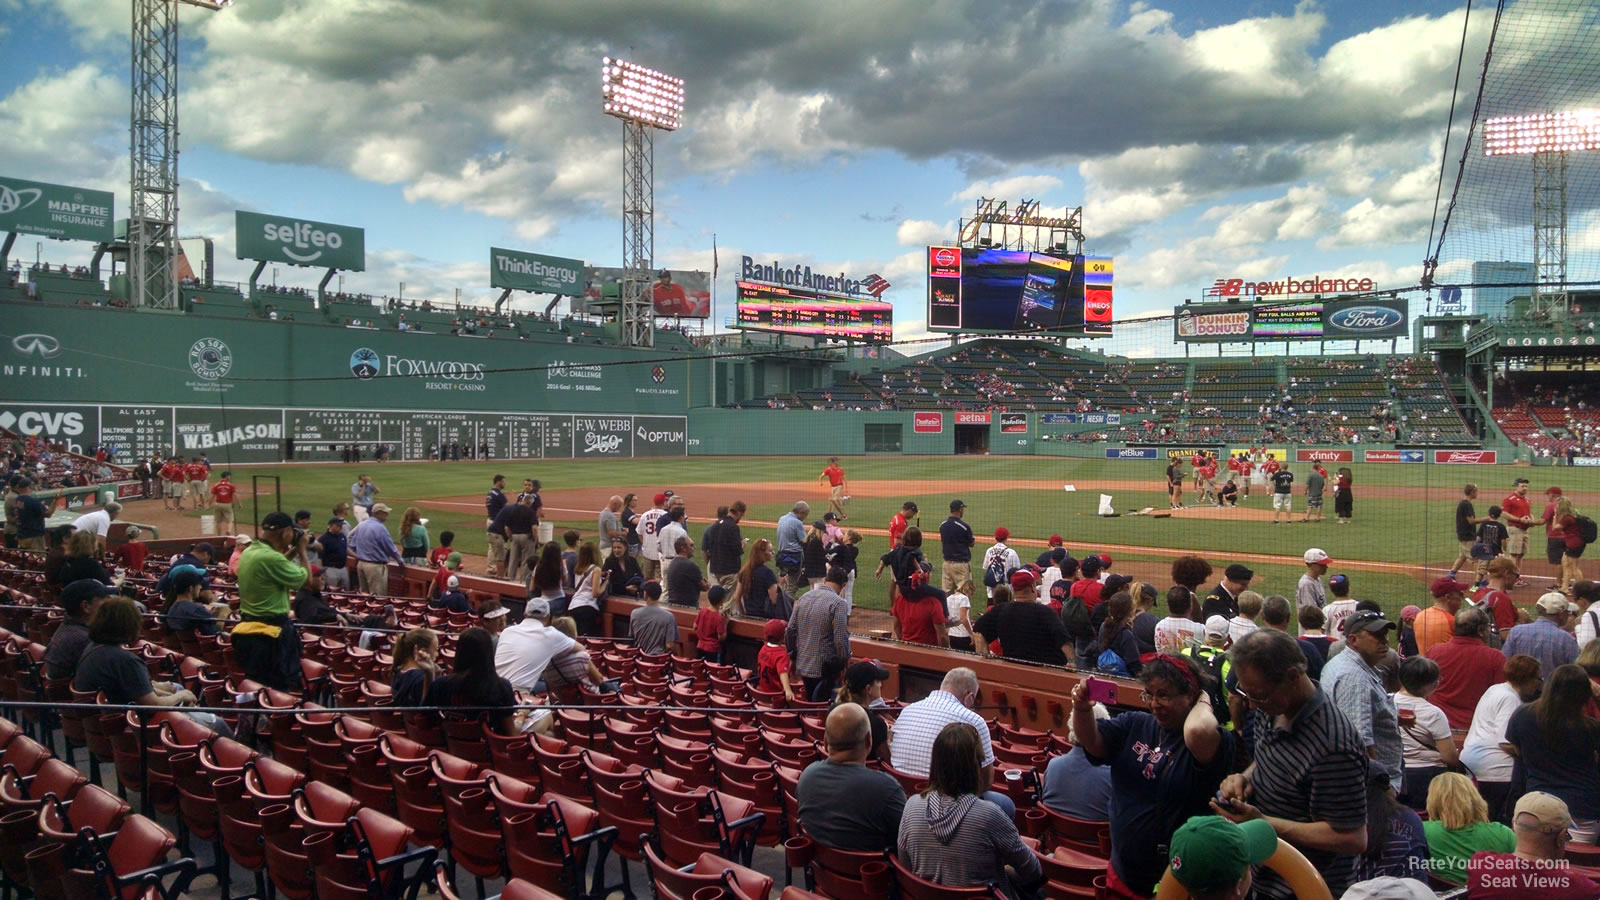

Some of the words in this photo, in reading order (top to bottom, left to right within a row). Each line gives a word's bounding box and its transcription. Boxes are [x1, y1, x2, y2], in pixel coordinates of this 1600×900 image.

[48, 200, 109, 216] MAPFRE
[52, 212, 105, 228] INSURANCE
[960, 196, 1011, 242] John
[1009, 198, 1086, 241] Hancock
[34, 226, 64, 235] Insurance
[264, 221, 342, 249] selfeo
[496, 255, 577, 284] ThinkEnergy
[742, 255, 784, 282] Bank
[785, 264, 804, 286] of
[802, 266, 860, 296] America
[1246, 280, 1284, 296] new
[1288, 275, 1372, 294] balance
[1198, 314, 1248, 324] DUNKIN'
[1343, 310, 1388, 327] Ford
[1198, 324, 1246, 333] DONUTS
[192, 342, 205, 357] RED
[208, 340, 224, 351] SOX
[4, 364, 84, 380] NFINITI
[193, 356, 229, 378] SCHOLARS
[386, 354, 484, 380] FOXWOODS
[569, 362, 601, 370] PAN-MASS
[458, 383, 486, 391] CASINO
[18, 411, 84, 435] CVS
[576, 419, 596, 431] F.W.
[599, 420, 631, 431] WEBB
[960, 414, 986, 422] aetna
[648, 431, 684, 442] OPTUM
[1119, 449, 1144, 458] jetBlue
[1309, 451, 1340, 460] xfinity
